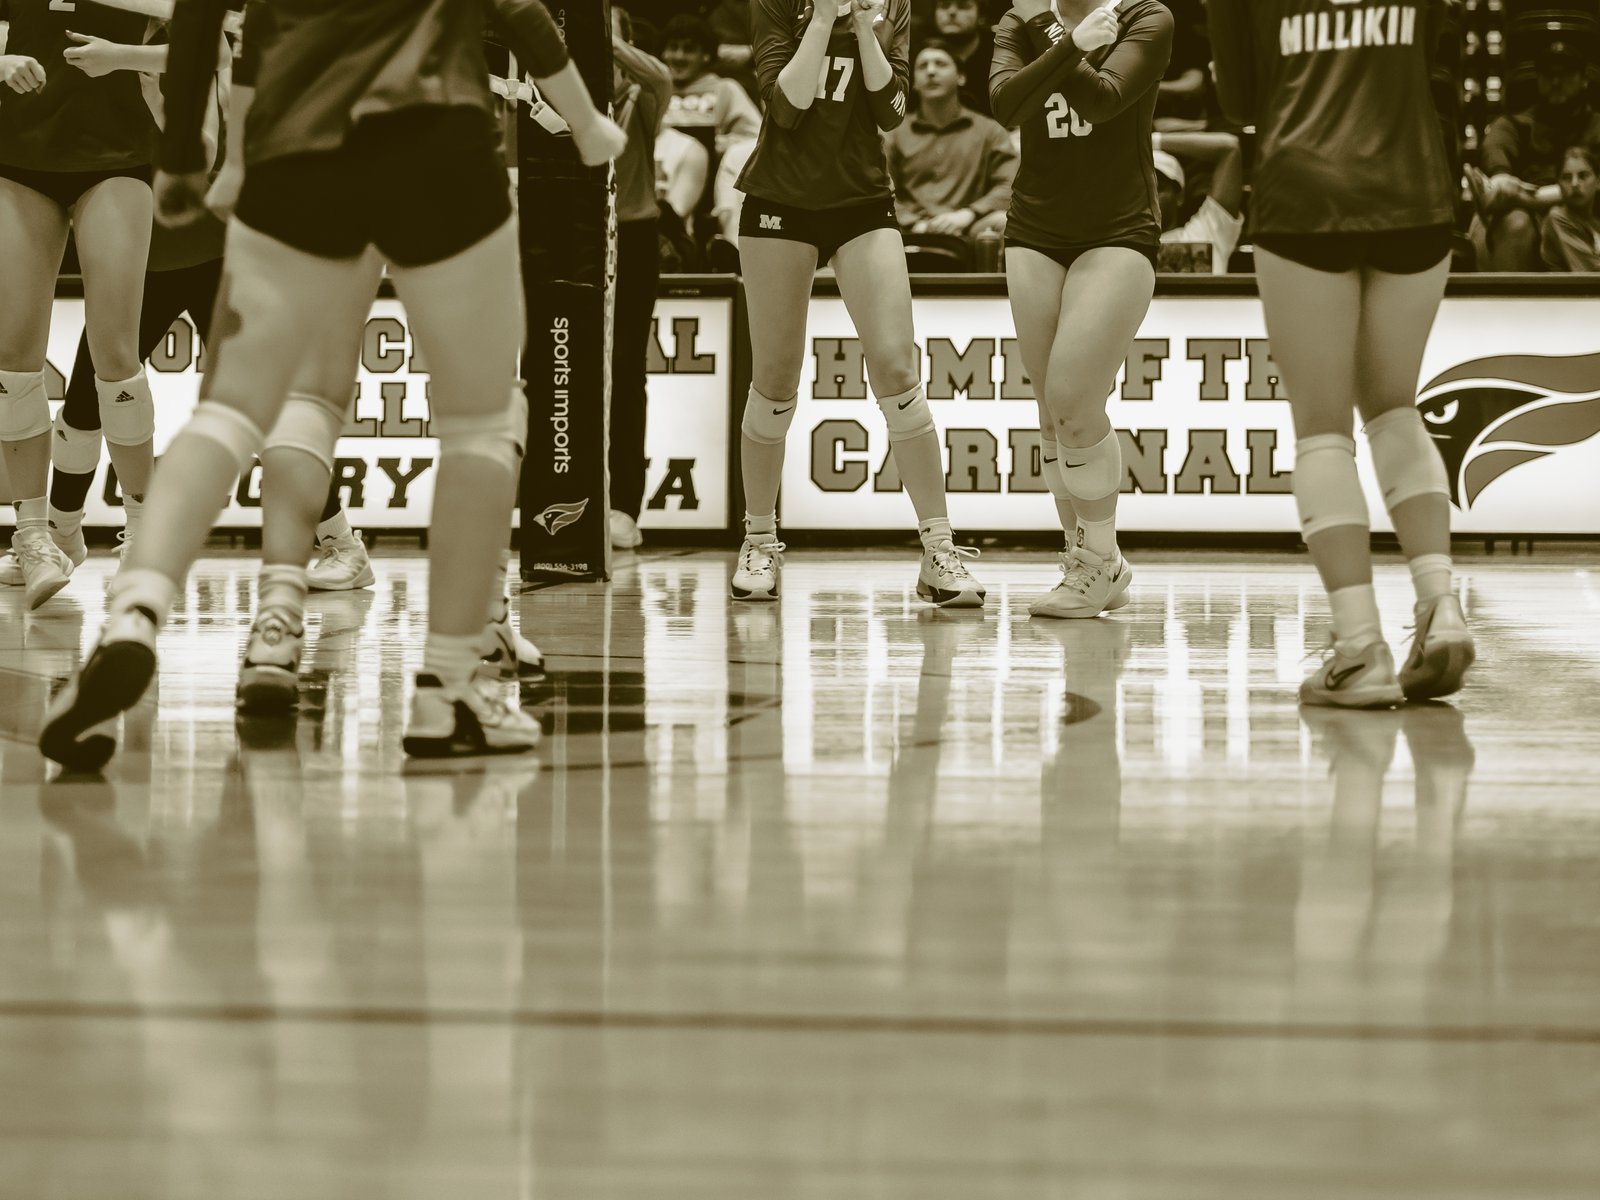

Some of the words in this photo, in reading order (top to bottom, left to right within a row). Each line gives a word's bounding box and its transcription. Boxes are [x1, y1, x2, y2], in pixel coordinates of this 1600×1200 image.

[1279, 4, 1417, 57] MILLIKIN
[759, 214, 783, 231] M
[550, 316, 572, 386] sports
[550, 389, 572, 474] imports
